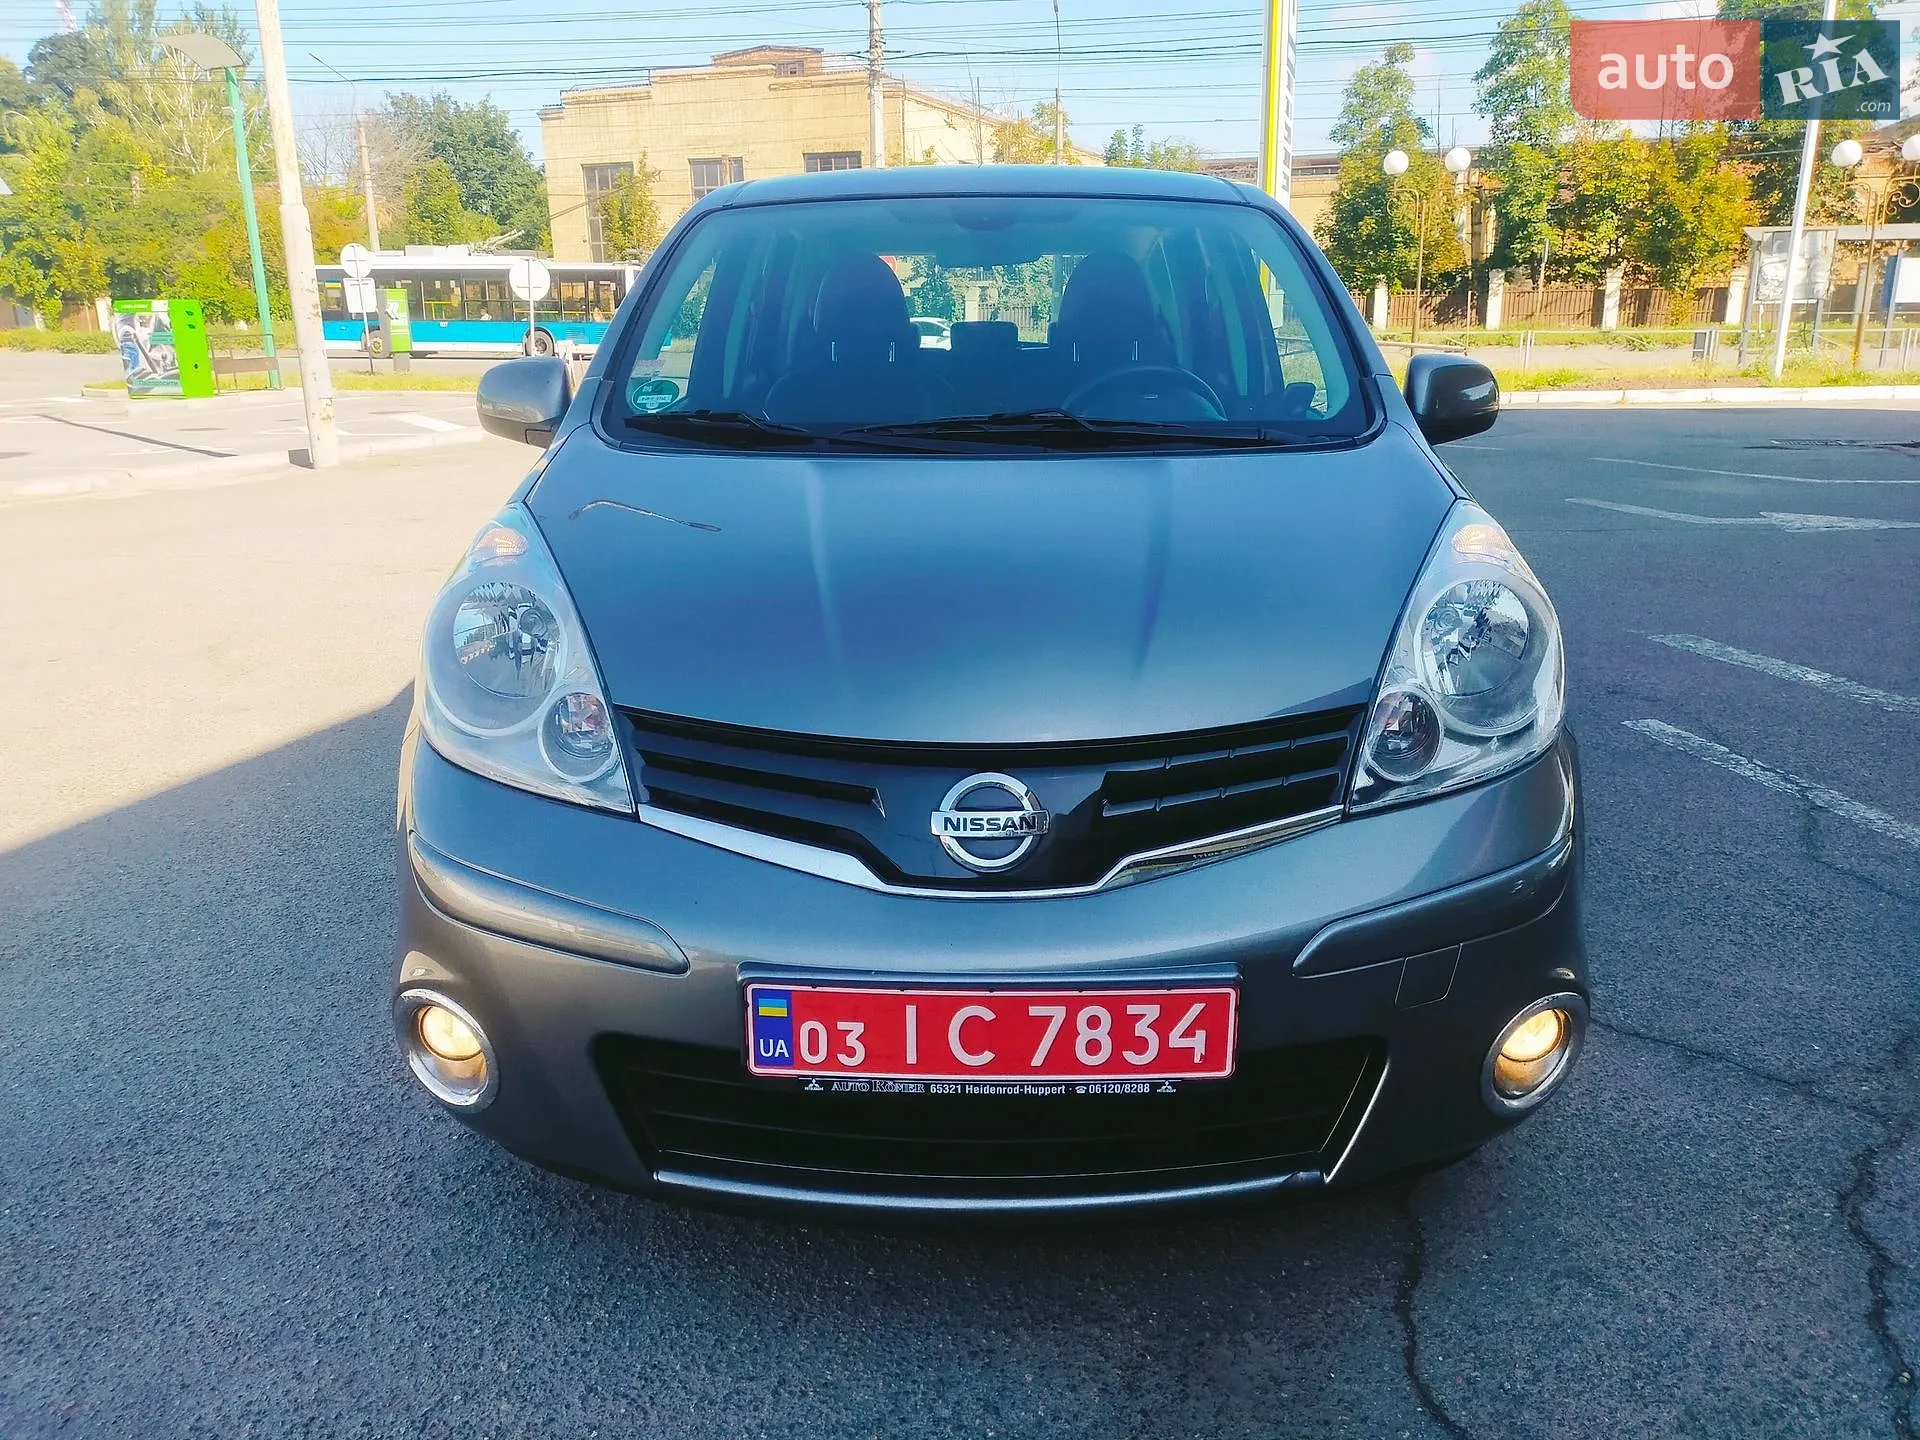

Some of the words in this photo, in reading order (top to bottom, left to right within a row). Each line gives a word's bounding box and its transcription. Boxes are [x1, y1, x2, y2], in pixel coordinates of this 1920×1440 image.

[943, 816, 1037, 832] NISSAN
[799, 1020, 866, 1066] 03
[1027, 1003, 1207, 1067] 7834
[760, 1039, 790, 1058] UA
[930, 1084, 962, 1094] 65321
[965, 1084, 1066, 1096] Heidenrod-Huppert
[1088, 1083, 1151, 1095] 06120/8288
